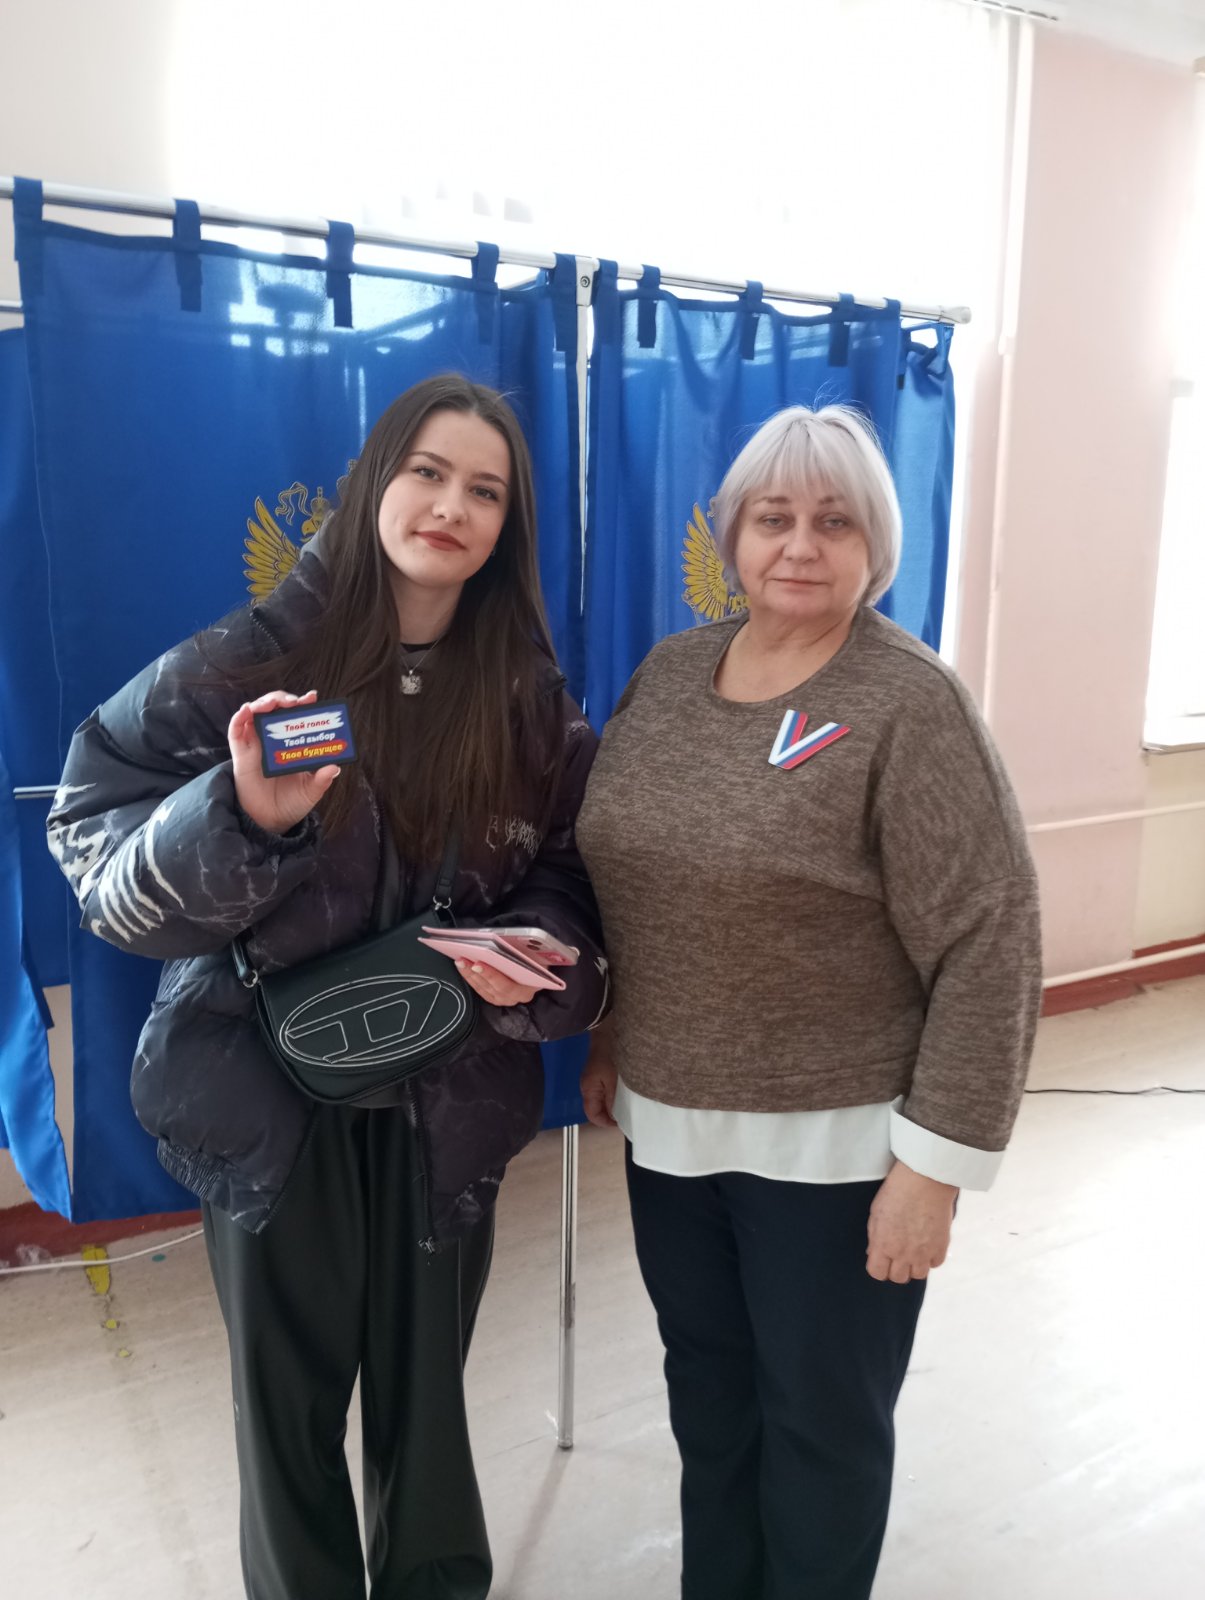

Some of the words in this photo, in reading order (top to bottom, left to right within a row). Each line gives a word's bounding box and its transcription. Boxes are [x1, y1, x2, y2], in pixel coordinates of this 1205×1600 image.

[285, 722, 305, 732] Твой
[307, 719, 330, 729] голос
[284, 736, 305, 747] Твой
[306, 732, 336, 743] выбор
[281, 751, 302, 760] Твое
[303, 744, 343, 757] будущее
